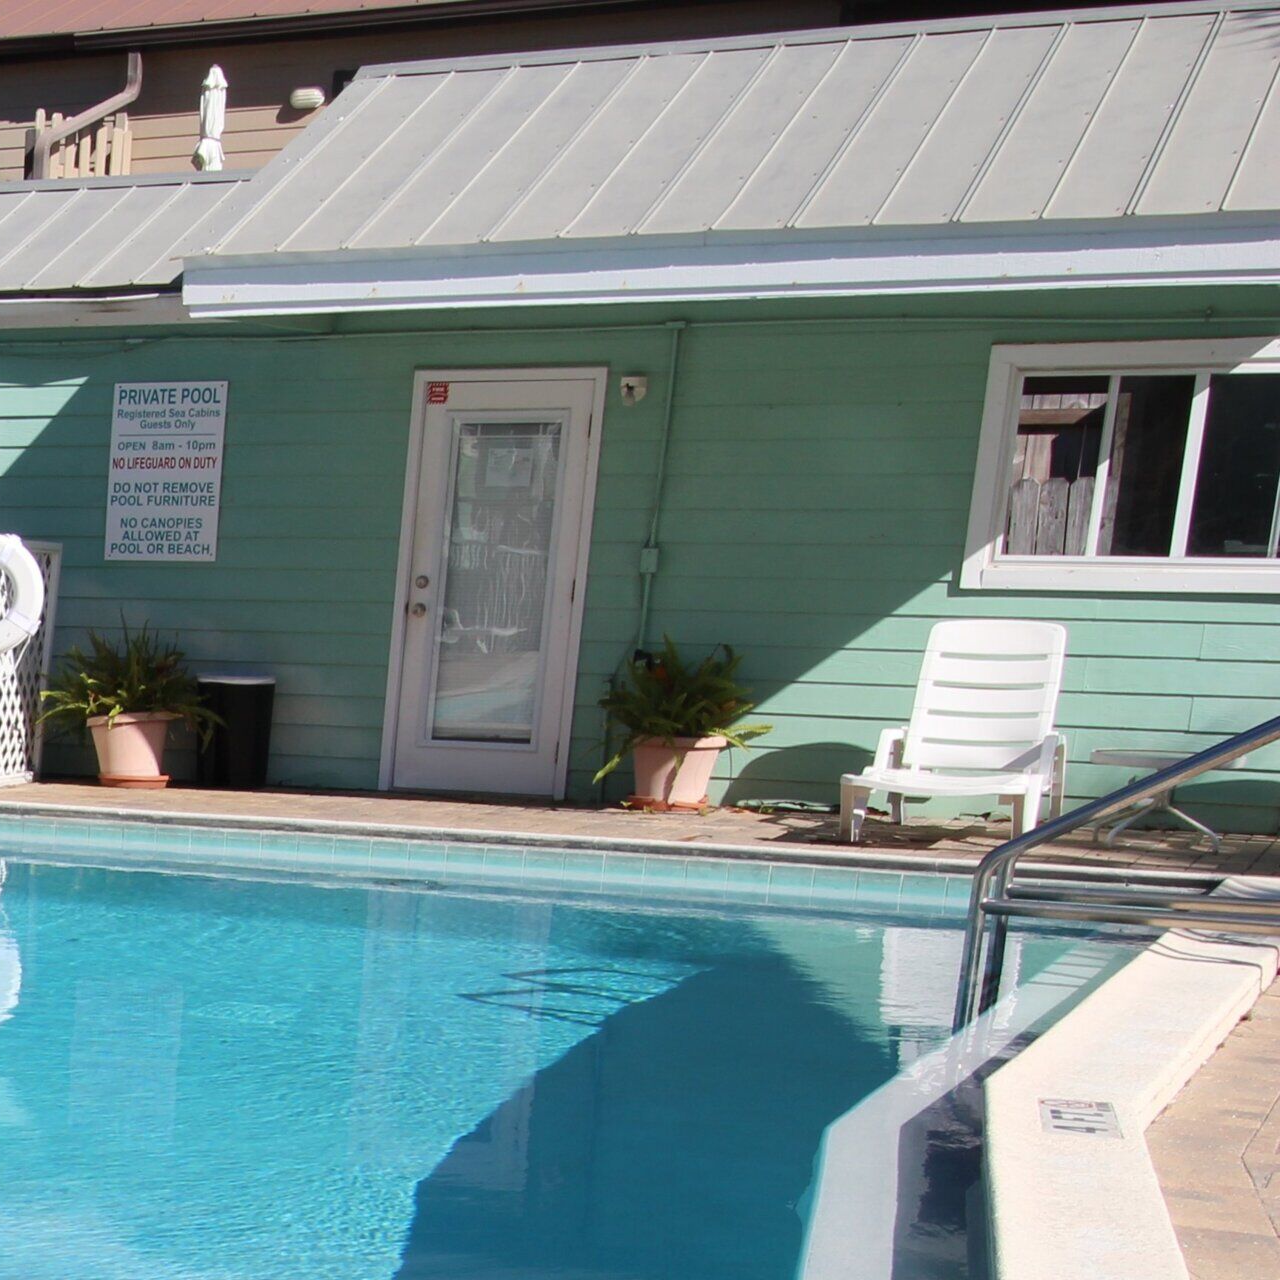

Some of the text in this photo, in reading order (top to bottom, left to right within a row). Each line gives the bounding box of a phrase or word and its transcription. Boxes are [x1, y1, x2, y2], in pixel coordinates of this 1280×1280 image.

[119, 387, 220, 405] PRIVATE POOL
[117, 408, 220, 420] Registered Sea Cabins
[140, 419, 195, 430] Guests Only
[118, 442, 146, 451] OPEN
[152, 441, 175, 450] 8am
[186, 440, 216, 451] 10pm
[112, 457, 218, 469] NO LIFEGUARD ON DUTY
[113, 482, 214, 493] DO NOT REMOVE
[110, 495, 215, 506] POOL FURNITURE
[120, 518, 203, 529] NO CANOPIES
[122, 530, 200, 541] ALLOWED AT
[110, 543, 143, 554] POOL
[147, 543, 164, 554] OR
